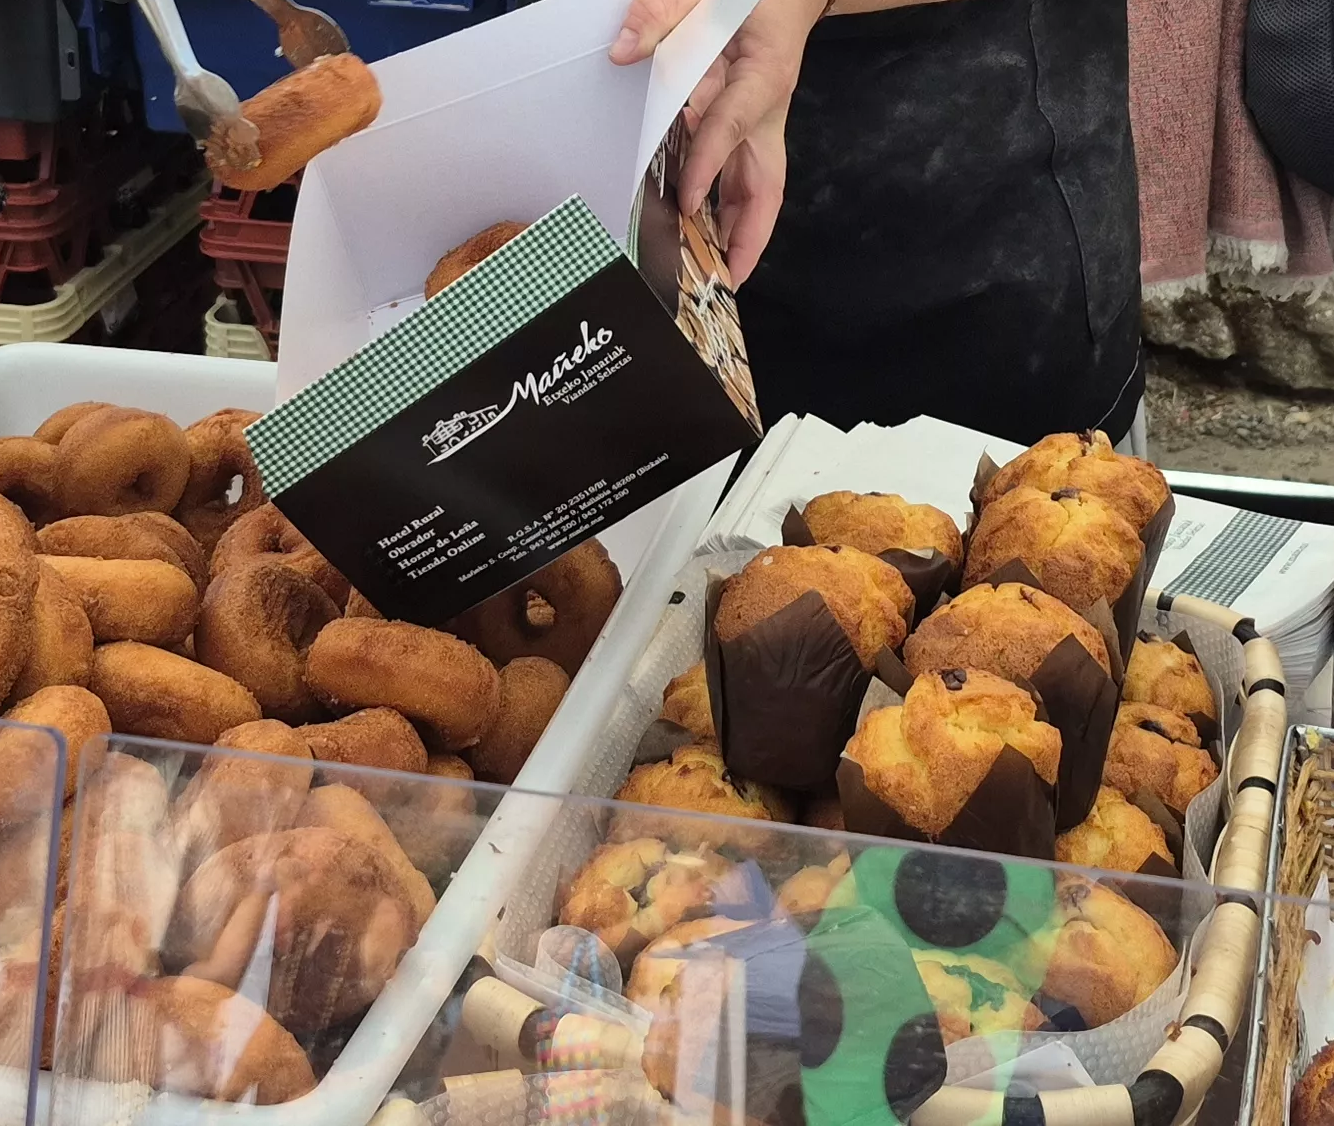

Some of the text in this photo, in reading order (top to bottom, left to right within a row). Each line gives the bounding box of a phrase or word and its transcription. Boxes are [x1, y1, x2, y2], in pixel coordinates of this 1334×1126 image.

[511, 320, 614, 406] Mañeko
[542, 345, 626, 406] Etxeko Janariak
[561, 354, 633, 405] Viandas Selectas
[377, 505, 445, 549] Hotel Rural
[388, 528, 437, 559] Obrador
[397, 520, 479, 570] Horno de Leña
[407, 533, 486, 579] Tienda Online
